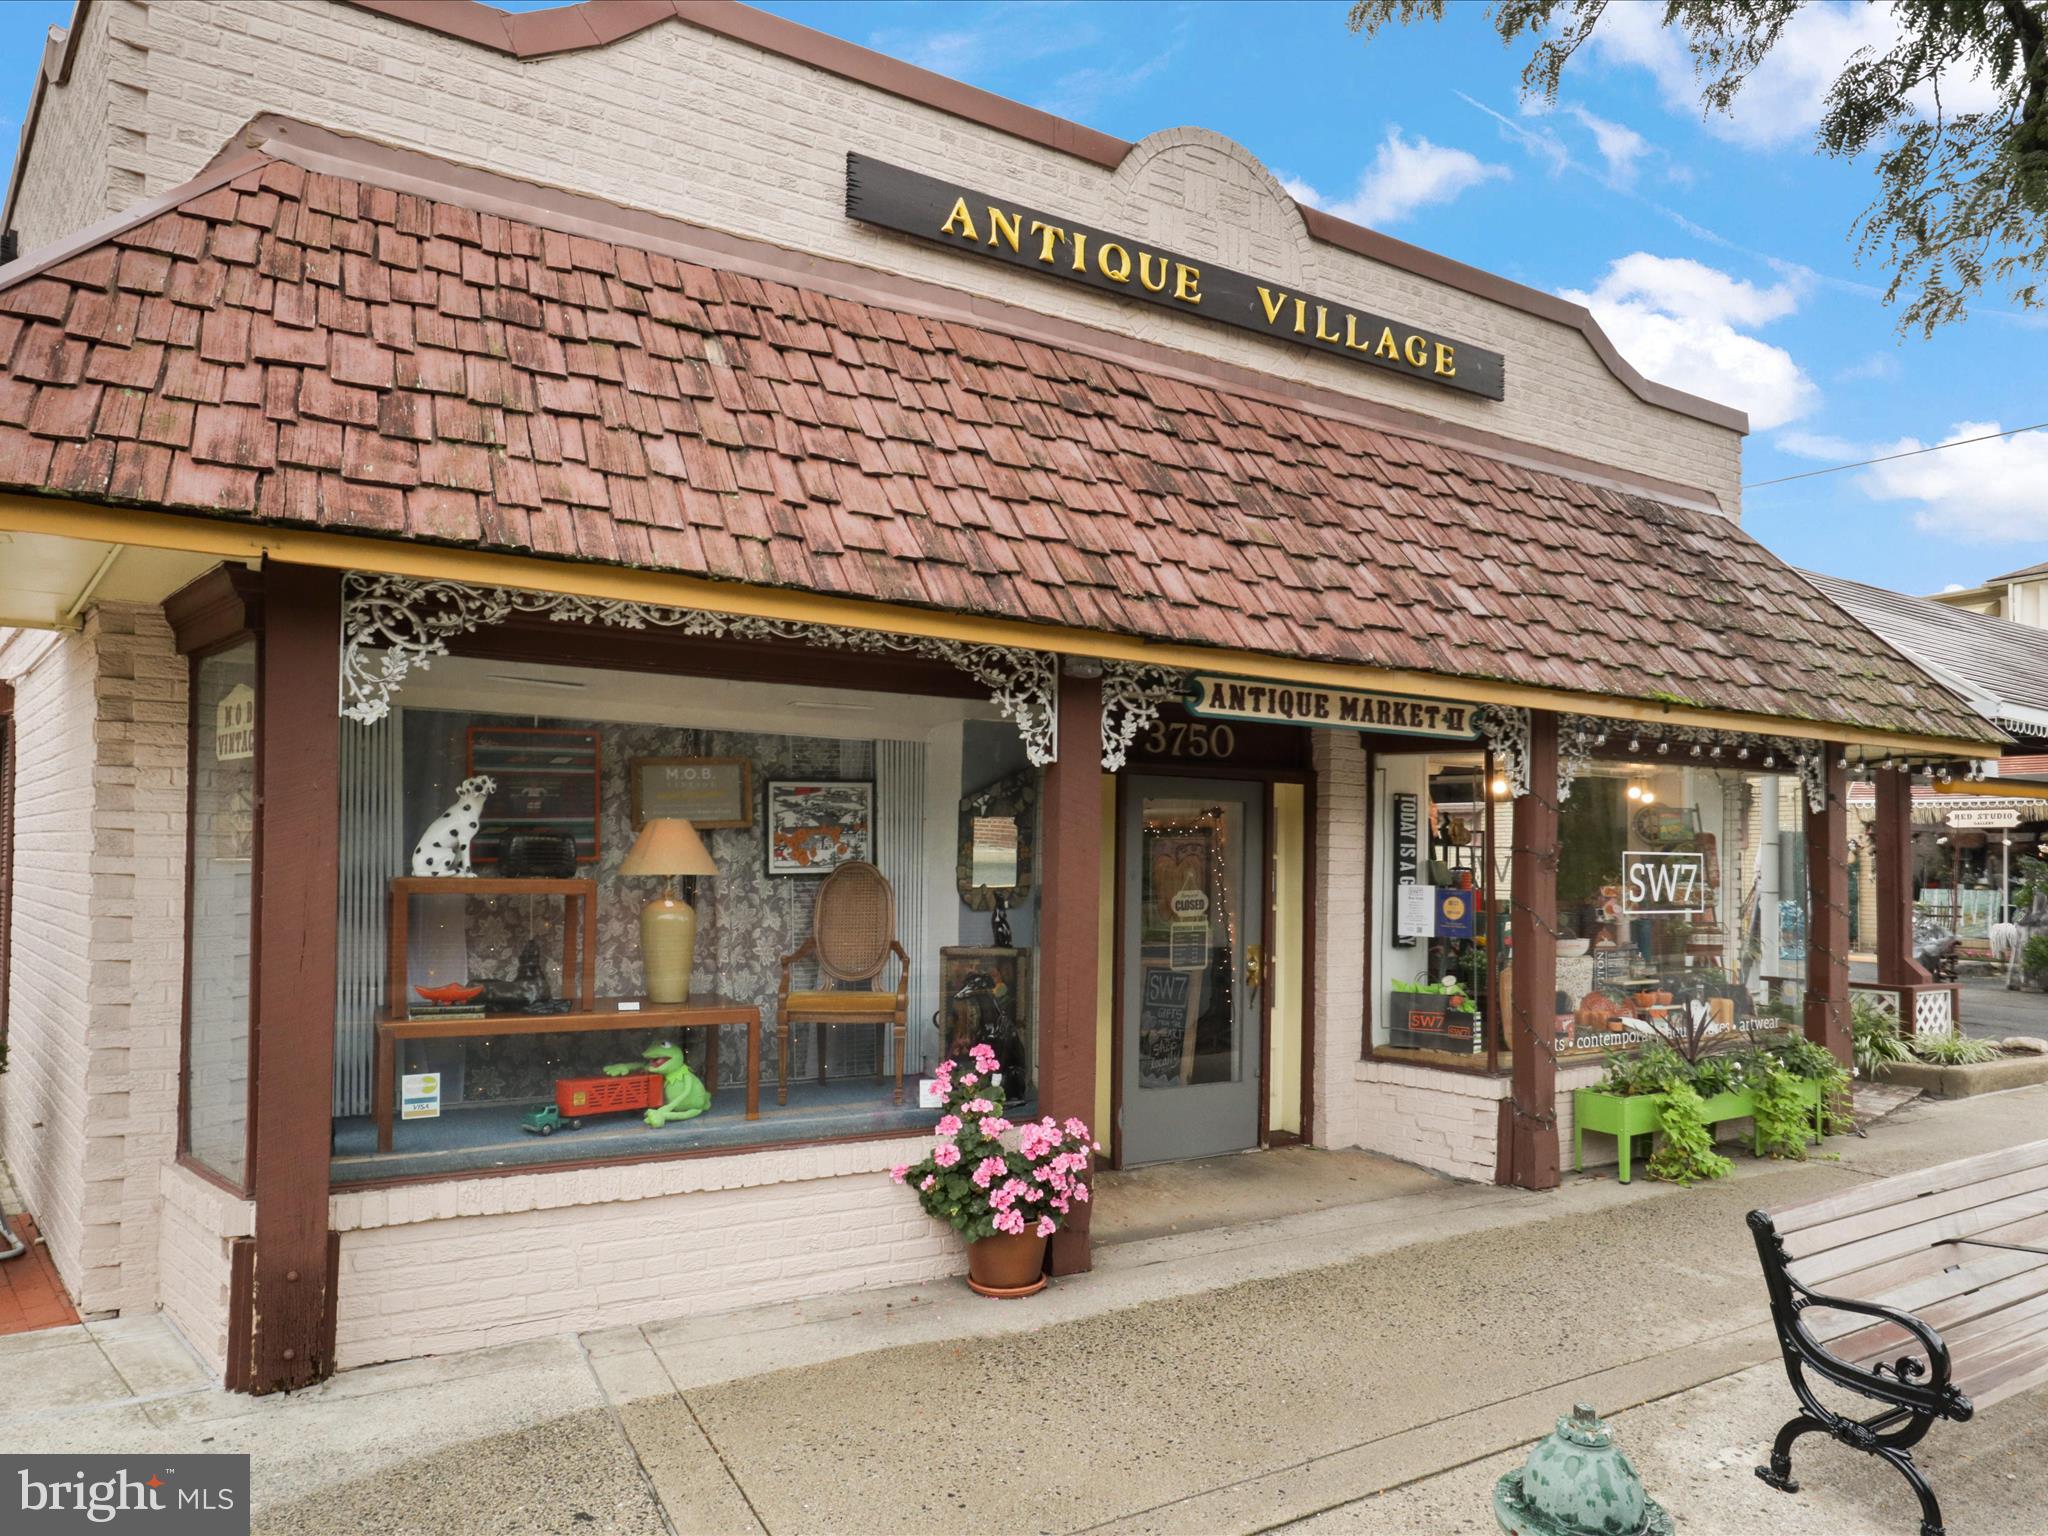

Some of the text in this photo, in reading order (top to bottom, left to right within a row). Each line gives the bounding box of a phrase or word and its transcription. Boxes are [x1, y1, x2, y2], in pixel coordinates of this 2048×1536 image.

[941, 197, 1457, 379] ANTIQUE VILLAGE
[1209, 682, 1330, 719] ANTIQUE
[1339, 696, 1440, 730] MARKET
[218, 728, 254, 756] VINTAG
[1145, 719, 1235, 758] 3750
[1399, 795, 1416, 839] TODAY
[1977, 812, 2013, 821] STUDIO
[1400, 843, 1416, 858] IS
[1400, 861, 1416, 872] A
[1629, 862, 1698, 903] SW7
[1175, 898, 1206, 912] CLOSED
[1150, 973, 1188, 1001] SW7
[1411, 1014, 1445, 1029] SW7
[1739, 1016, 1779, 1032] artwear
[413, 1103, 430, 1111] VISA
